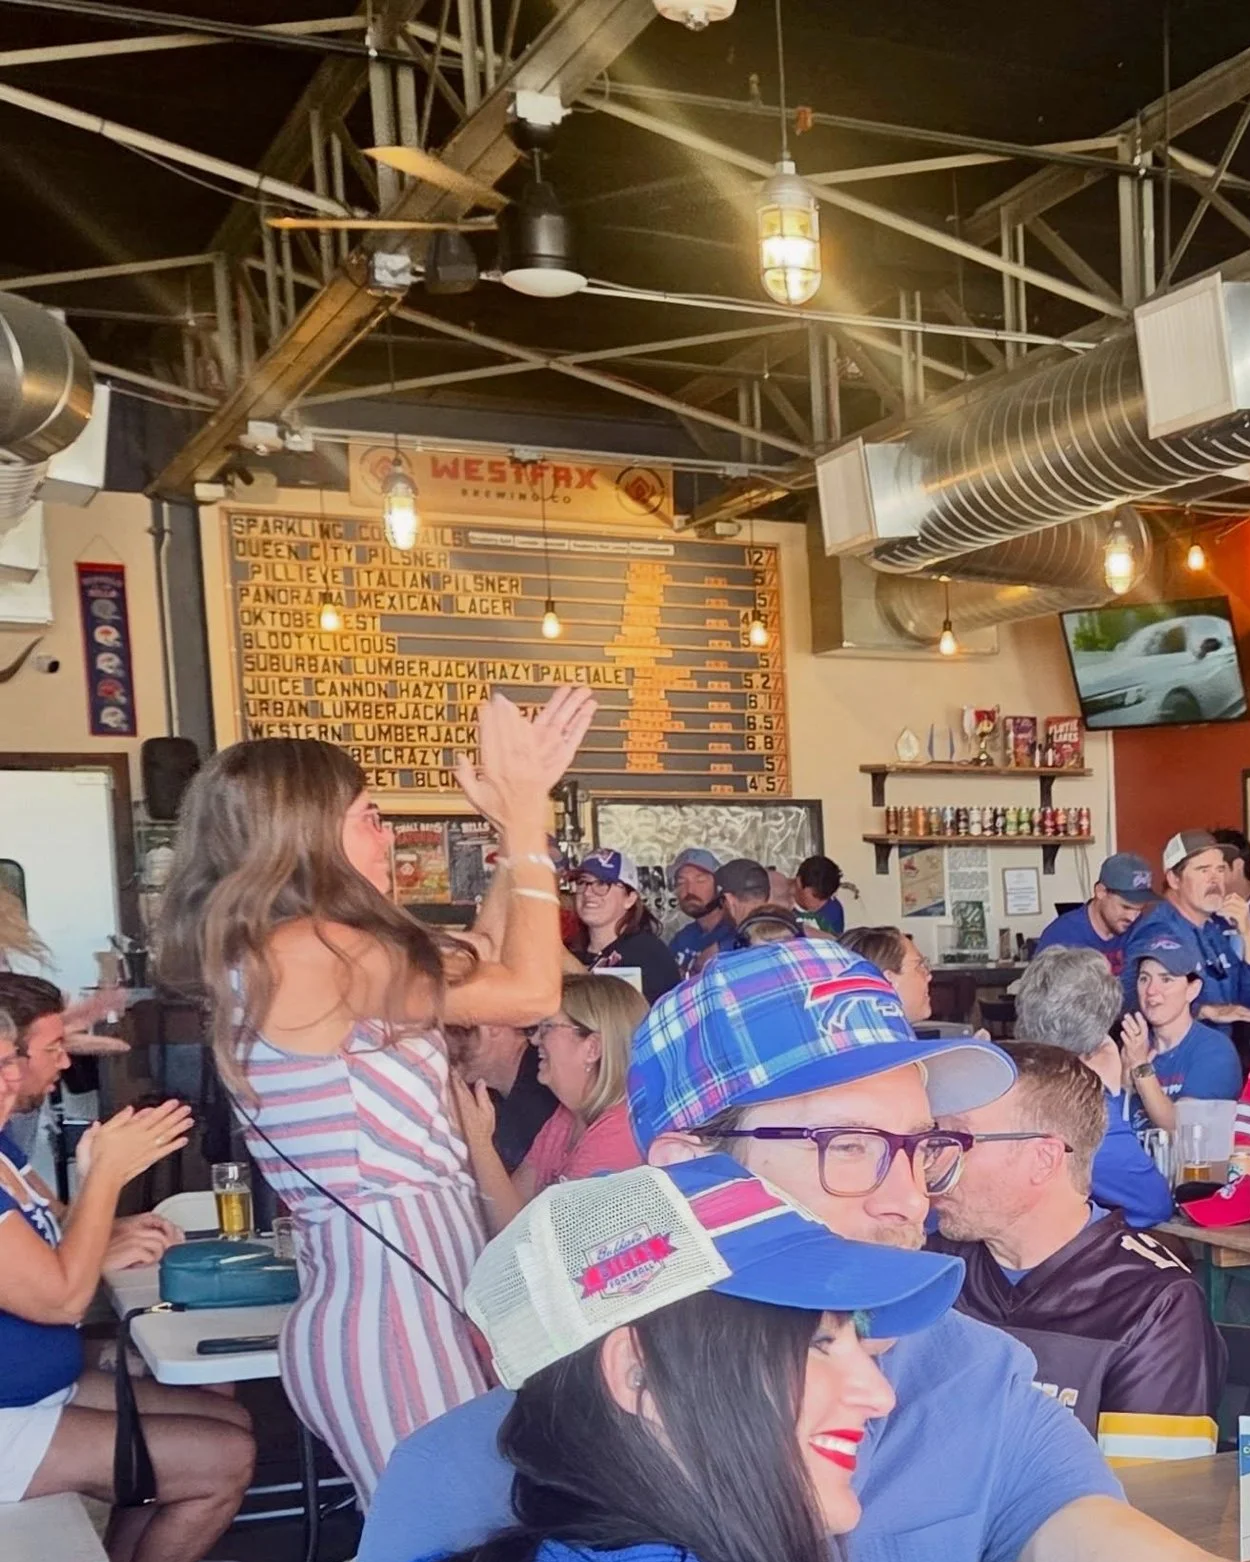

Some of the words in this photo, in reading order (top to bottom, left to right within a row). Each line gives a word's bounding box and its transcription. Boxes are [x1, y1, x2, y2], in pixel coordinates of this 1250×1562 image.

[431, 457, 599, 489] WESTFAX
[232, 516, 343, 539] SPARKLING
[358, 524, 464, 547] COAILS
[236, 540, 299, 560] QUEEN
[309, 543, 353, 561] CITY
[367, 548, 448, 568] PILSNER
[354, 569, 431, 588] ITALIAN
[442, 574, 519, 596] PILSNER
[357, 591, 441, 613] MEXICAN
[454, 595, 512, 616] LAGER
[240, 608, 377, 631] OKTOBEEST
[244, 655, 345, 675] SUBURBAN
[352, 660, 478, 679] LUMBERJACK
[488, 664, 533, 681] HAZY
[541, 666, 586, 684] PALE
[593, 668, 626, 685] ALE
[743, 672, 784, 690] 5.2%
[244, 678, 302, 697] JUICE
[313, 680, 389, 699] CANNON
[399, 683, 446, 701] HAZY
[458, 684, 489, 701] IPA
[247, 700, 309, 718] URBAN
[320, 702, 446, 721] LUMBERJACK
[748, 693, 784, 711] 6.1%
[250, 724, 342, 743] WESTERN
[352, 725, 477, 745] LUMBERJACK
[746, 714, 784, 732] 6.5%
[382, 748, 441, 766] CRAZY
[766, 754, 785, 772] 5%
[748, 776, 787, 793] 4.5%
[609, 1263, 655, 1288] FOOTBALL
